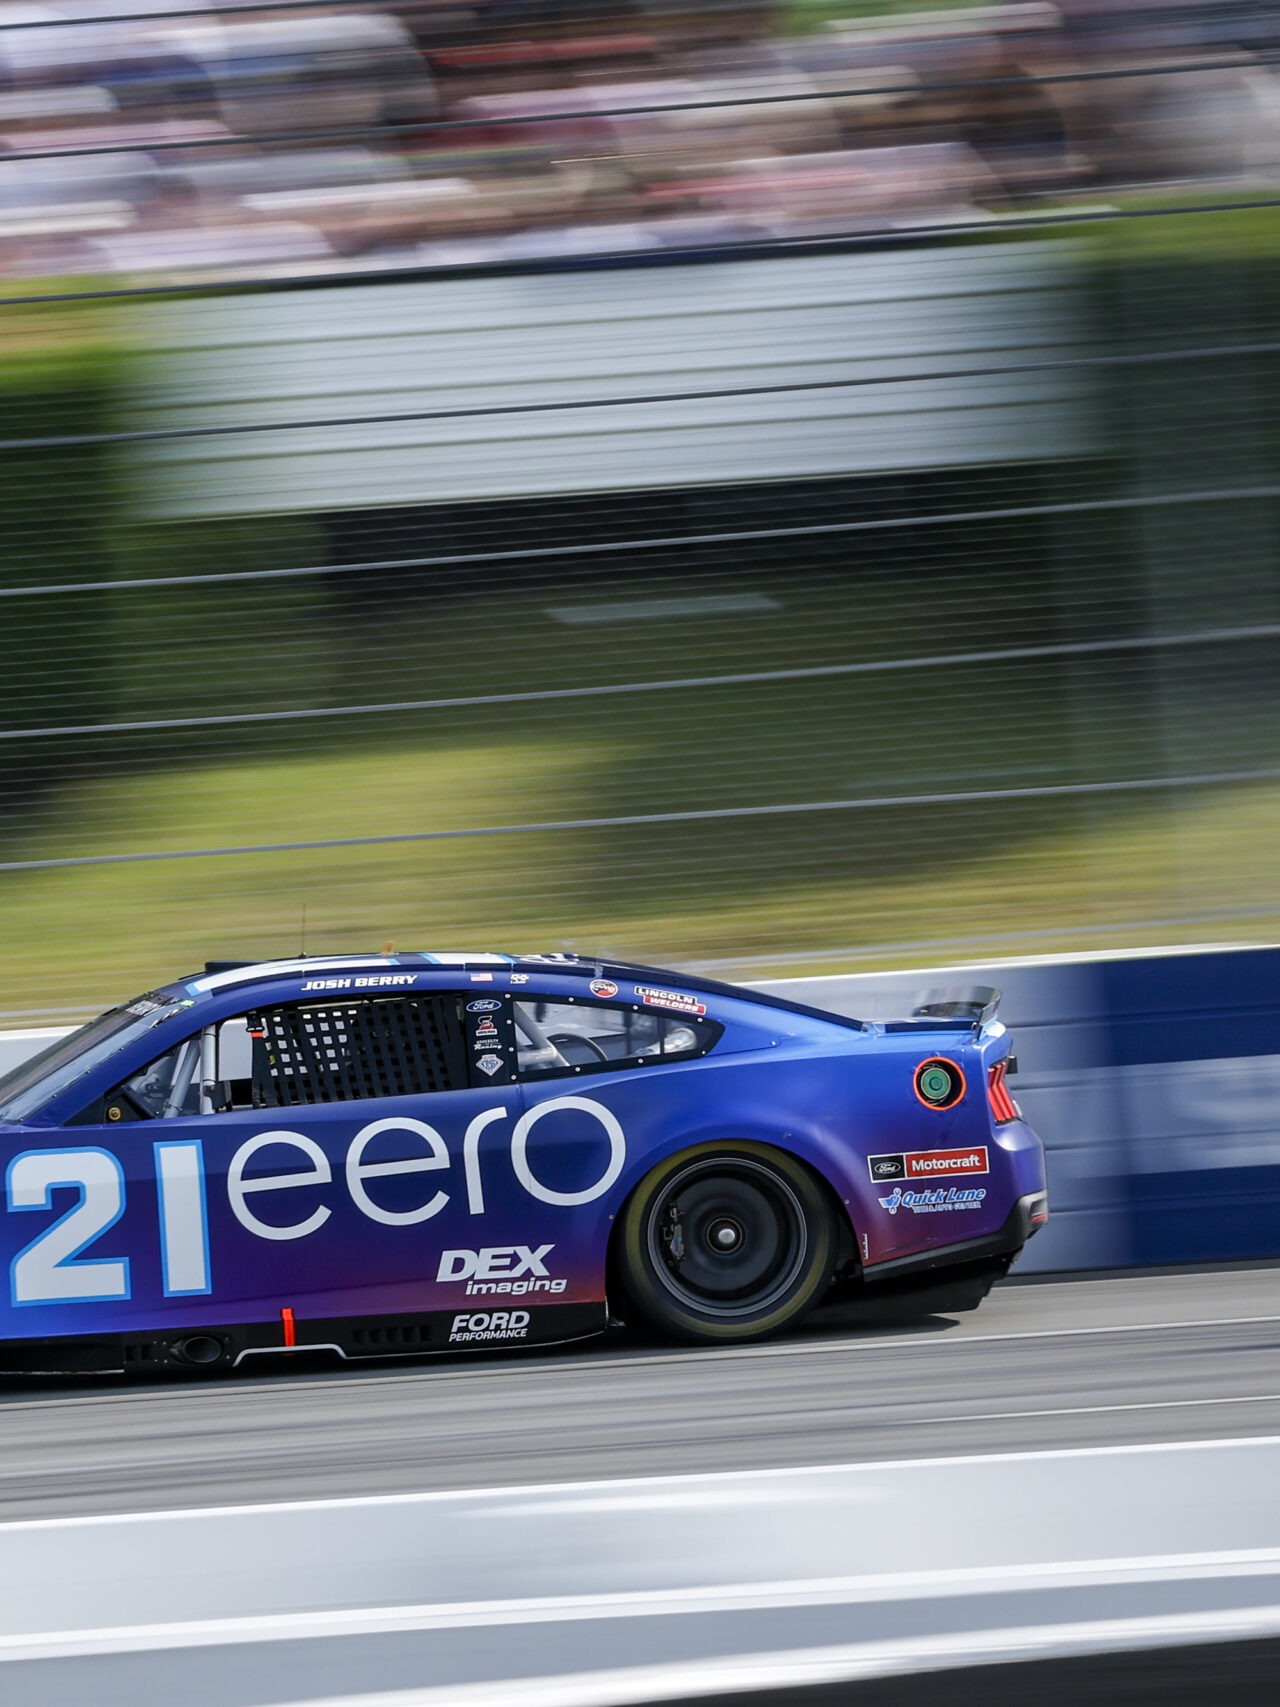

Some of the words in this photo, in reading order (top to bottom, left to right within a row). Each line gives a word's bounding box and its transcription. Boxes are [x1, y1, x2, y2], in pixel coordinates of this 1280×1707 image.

[301, 978, 351, 991] JOSH
[354, 975, 418, 987] BERRY
[637, 987, 695, 1004] LINCOLN
[649, 997, 700, 1012] WELDERS
[227, 1096, 626, 1241] eero
[911, 1155, 980, 1171] Motorcraft
[902, 1189, 947, 1207] Quick
[947, 1188, 986, 1203] Lane
[6, 1140, 213, 1306] 21
[436, 1244, 556, 1282] DEX
[465, 1277, 567, 1295] imaging
[451, 1311, 530, 1332] FORD
[449, 1328, 528, 1342] PERFORMANCE
